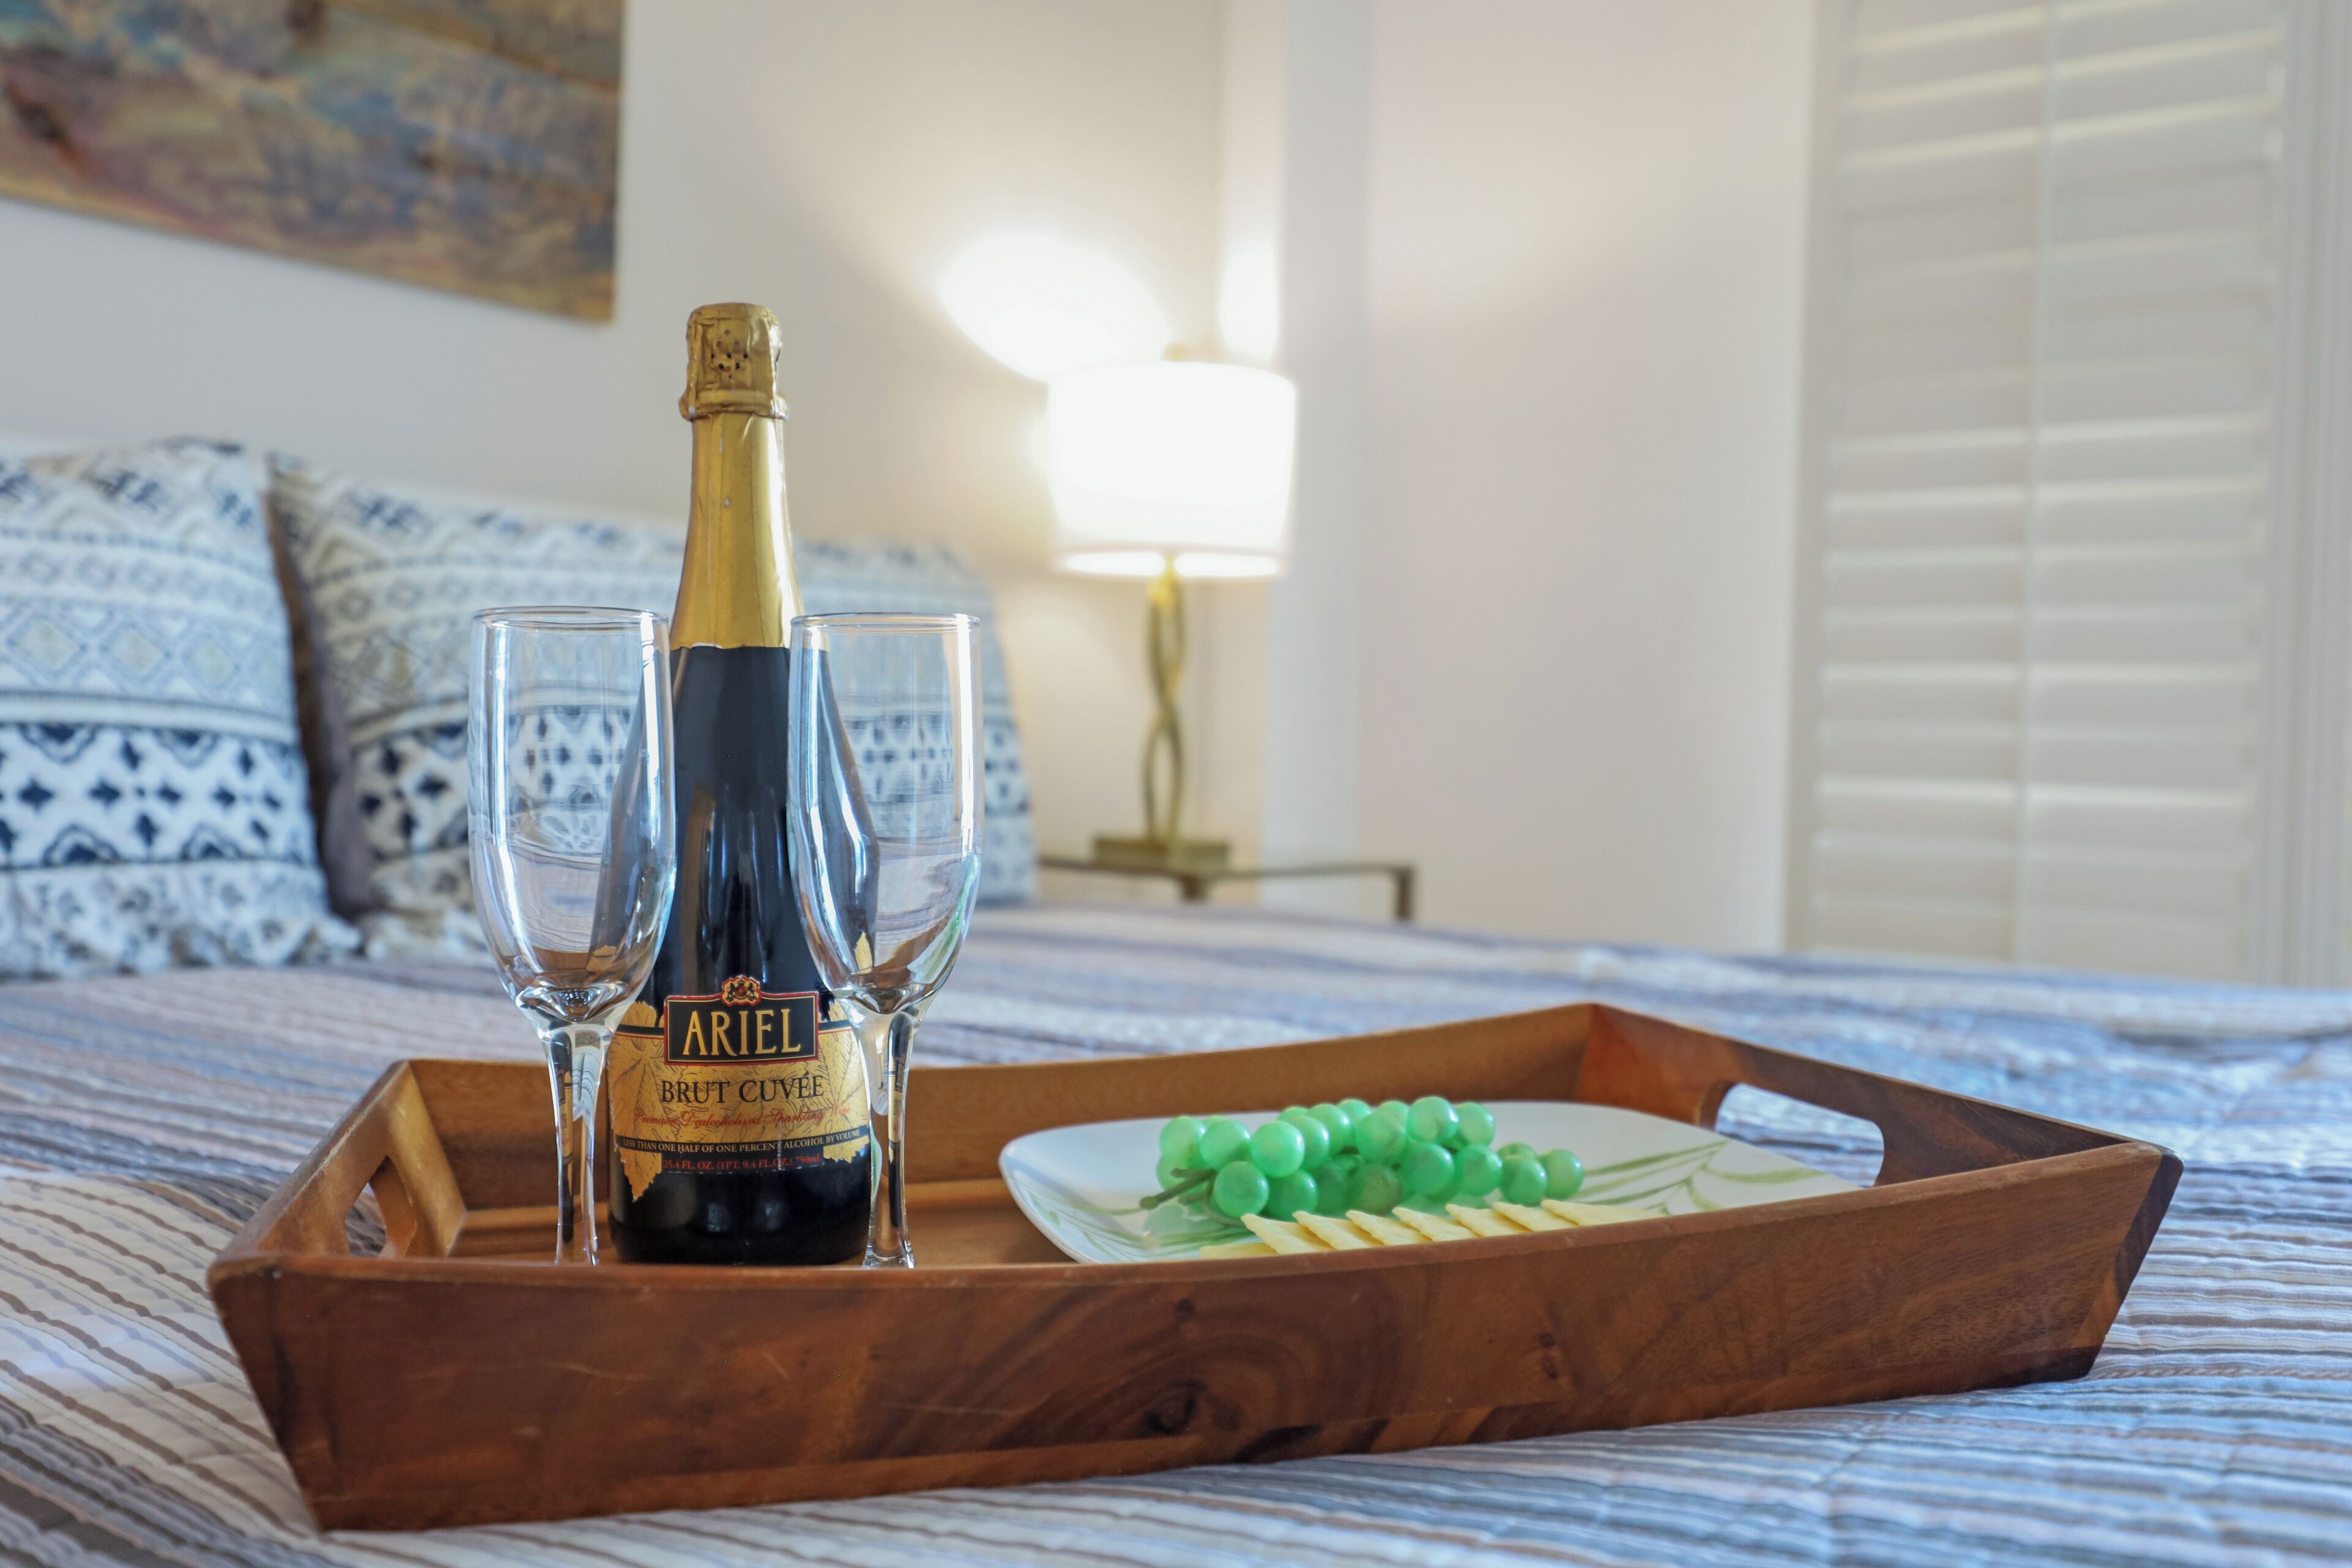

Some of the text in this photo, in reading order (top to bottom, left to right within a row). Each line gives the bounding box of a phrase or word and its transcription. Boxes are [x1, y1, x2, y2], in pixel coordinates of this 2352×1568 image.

[682, 1008, 801, 1057] ARIEL
[661, 1069, 824, 1103] BRUT CUVÉE
[635, 1107, 677, 1126] Premium
[680, 1110, 761, 1128] Dealcoholized
[766, 1106, 824, 1128] Sparkling
[624, 1139, 636, 1147] LESS
[638, 1140, 657, 1150] THAN
[658, 1143, 676, 1152] ONE
[739, 1142, 782, 1152] PERCENT
[784, 1137, 824, 1149] ALCOHOL
[826, 1134, 835, 1144] BY
[835, 1129, 861, 1142] VOLUME
